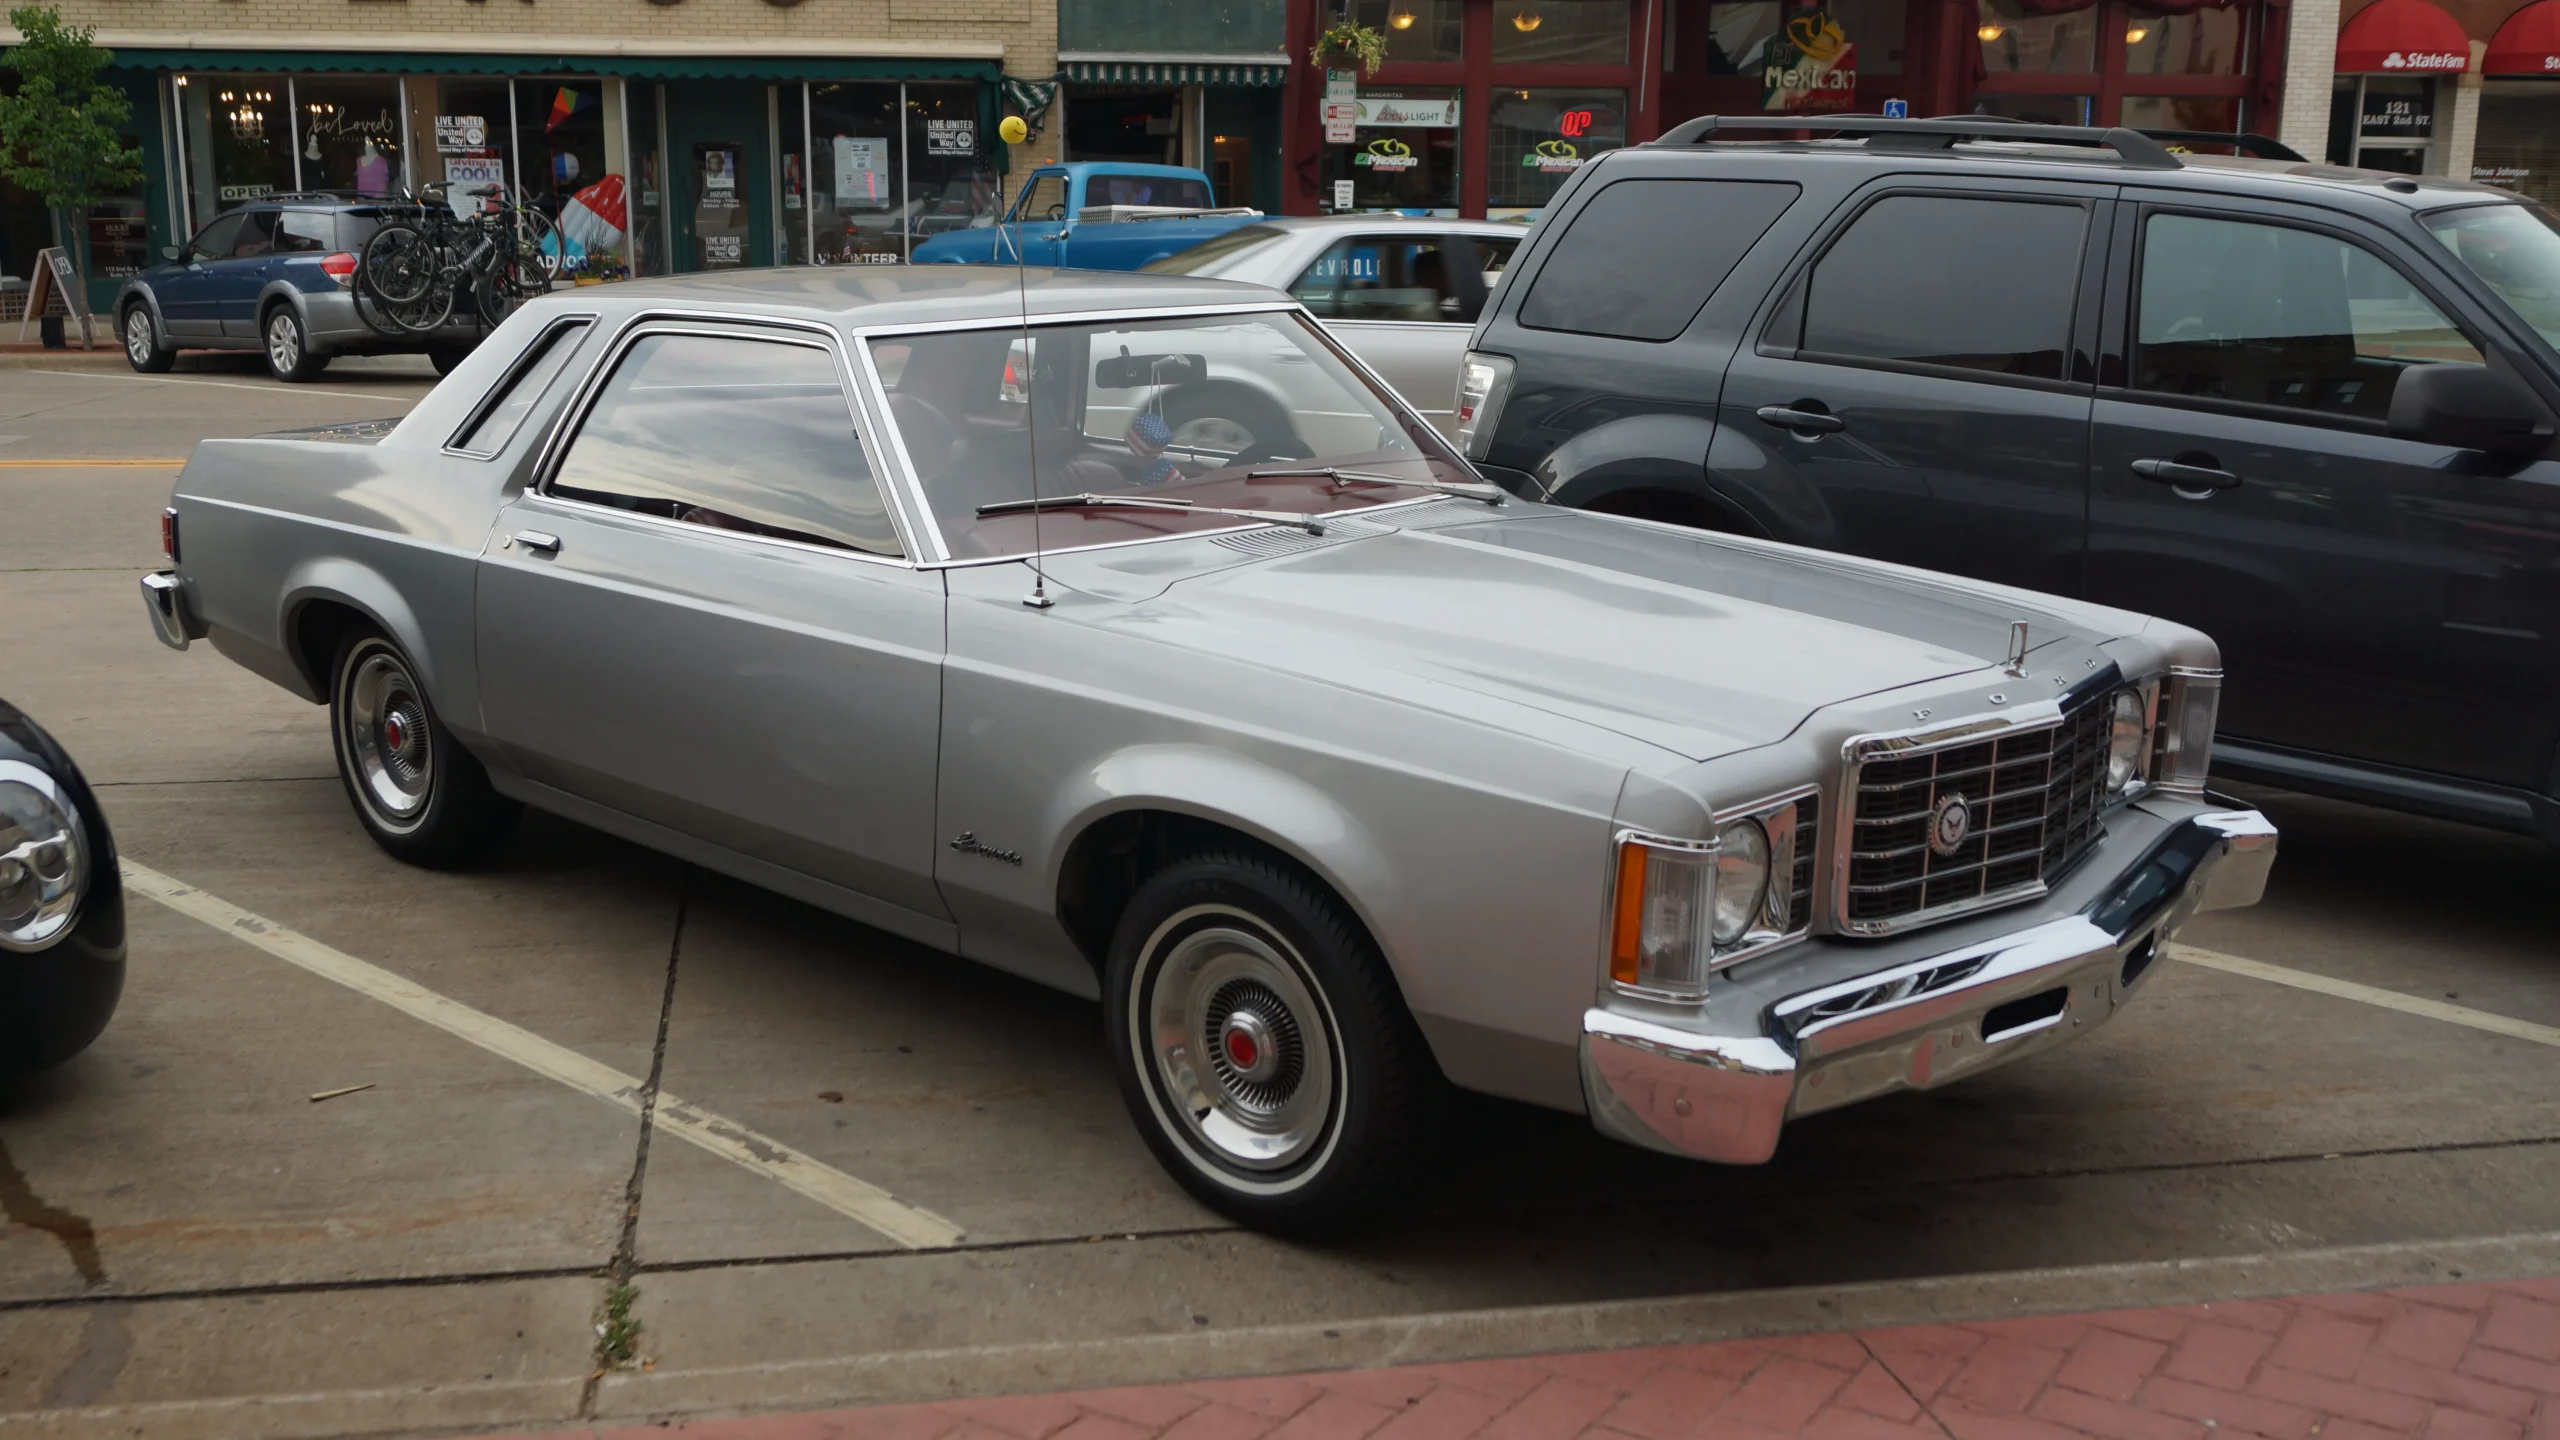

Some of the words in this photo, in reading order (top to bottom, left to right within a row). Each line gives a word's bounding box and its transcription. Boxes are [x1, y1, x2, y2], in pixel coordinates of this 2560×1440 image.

[1765, 66, 1857, 90] Mexican
[1328, 107, 1336, 116] NO
[2385, 102, 2410, 114] 121
[435, 116, 453, 125] LIVE
[455, 116, 484, 126] UNITED
[1410, 112, 1440, 121] LIGHT
[2363, 115, 2390, 125] EAST
[2393, 115, 2412, 125] 2nd
[928, 120, 944, 128] LIVE
[946, 120, 973, 129] UNITED
[437, 128, 463, 136] United
[930, 131, 954, 139] United
[448, 136, 464, 145] Way
[940, 139, 954, 148] Way
[1368, 155, 1418, 166] Mexican
[1536, 156, 1584, 167] Mexican
[450, 167, 500, 181] COOL!
[2472, 167, 2494, 176] Steve
[2496, 167, 2530, 177] Johnson
[223, 187, 271, 199] OPEN
[54, 256, 74, 275] OPEN
